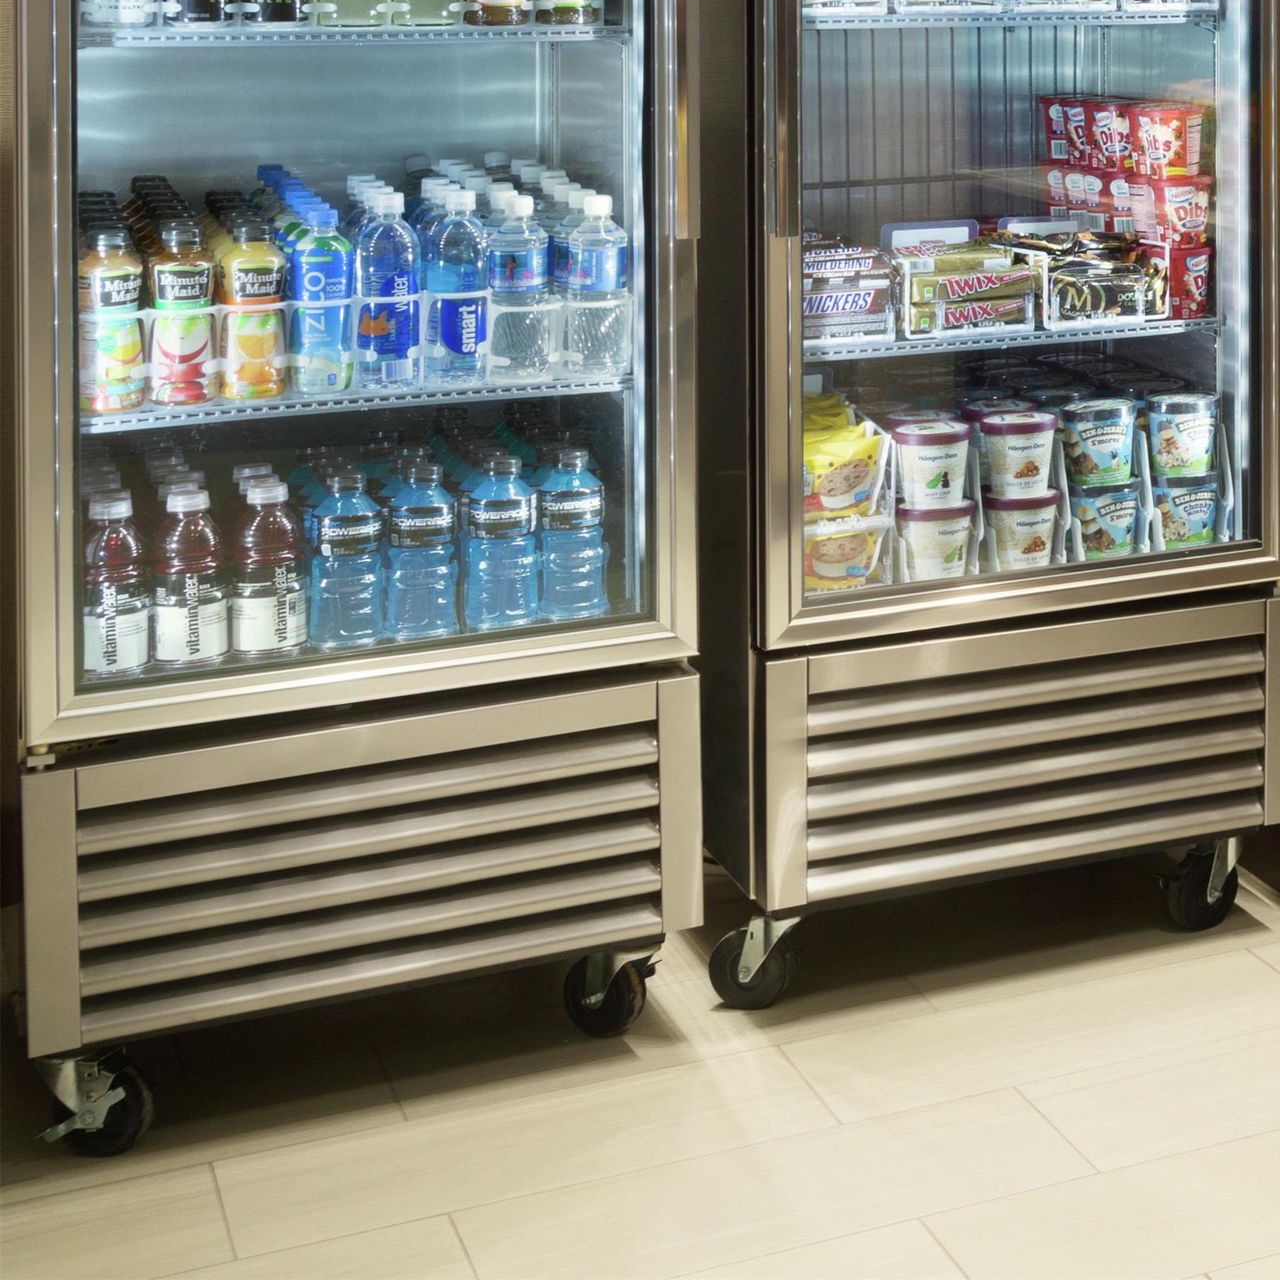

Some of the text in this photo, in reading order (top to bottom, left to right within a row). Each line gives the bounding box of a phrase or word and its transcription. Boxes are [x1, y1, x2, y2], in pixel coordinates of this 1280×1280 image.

[160, 272, 207, 287] Minute
[166, 284, 201, 297] Maid
[246, 283, 277, 295] Maid
[458, 304, 477, 354] smart
[103, 582, 118, 667] vitaminwater
[186, 573, 200, 656] vitaminwater
[272, 566, 289, 644] vitaminwater
